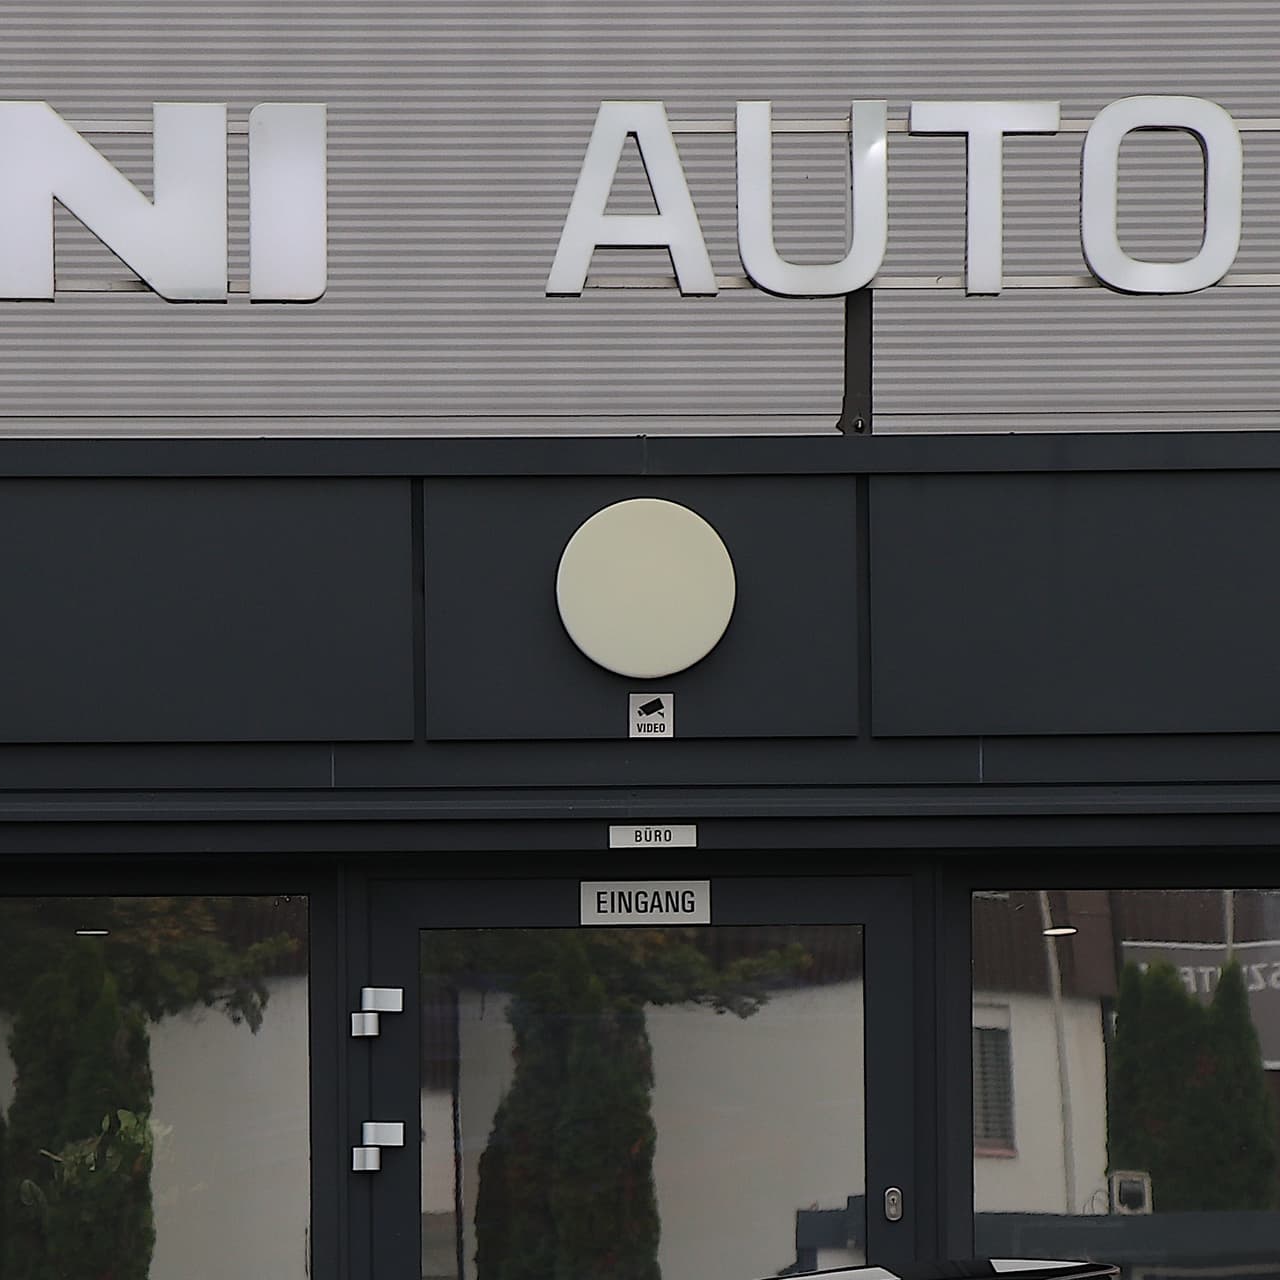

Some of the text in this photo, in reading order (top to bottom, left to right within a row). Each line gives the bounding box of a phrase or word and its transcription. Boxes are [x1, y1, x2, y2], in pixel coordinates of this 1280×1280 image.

[545, 94, 1244, 299] AUTO
[636, 722, 666, 734] VIDEO
[634, 826, 673, 843] BÜRO
[595, 890, 696, 914] EINGANG
